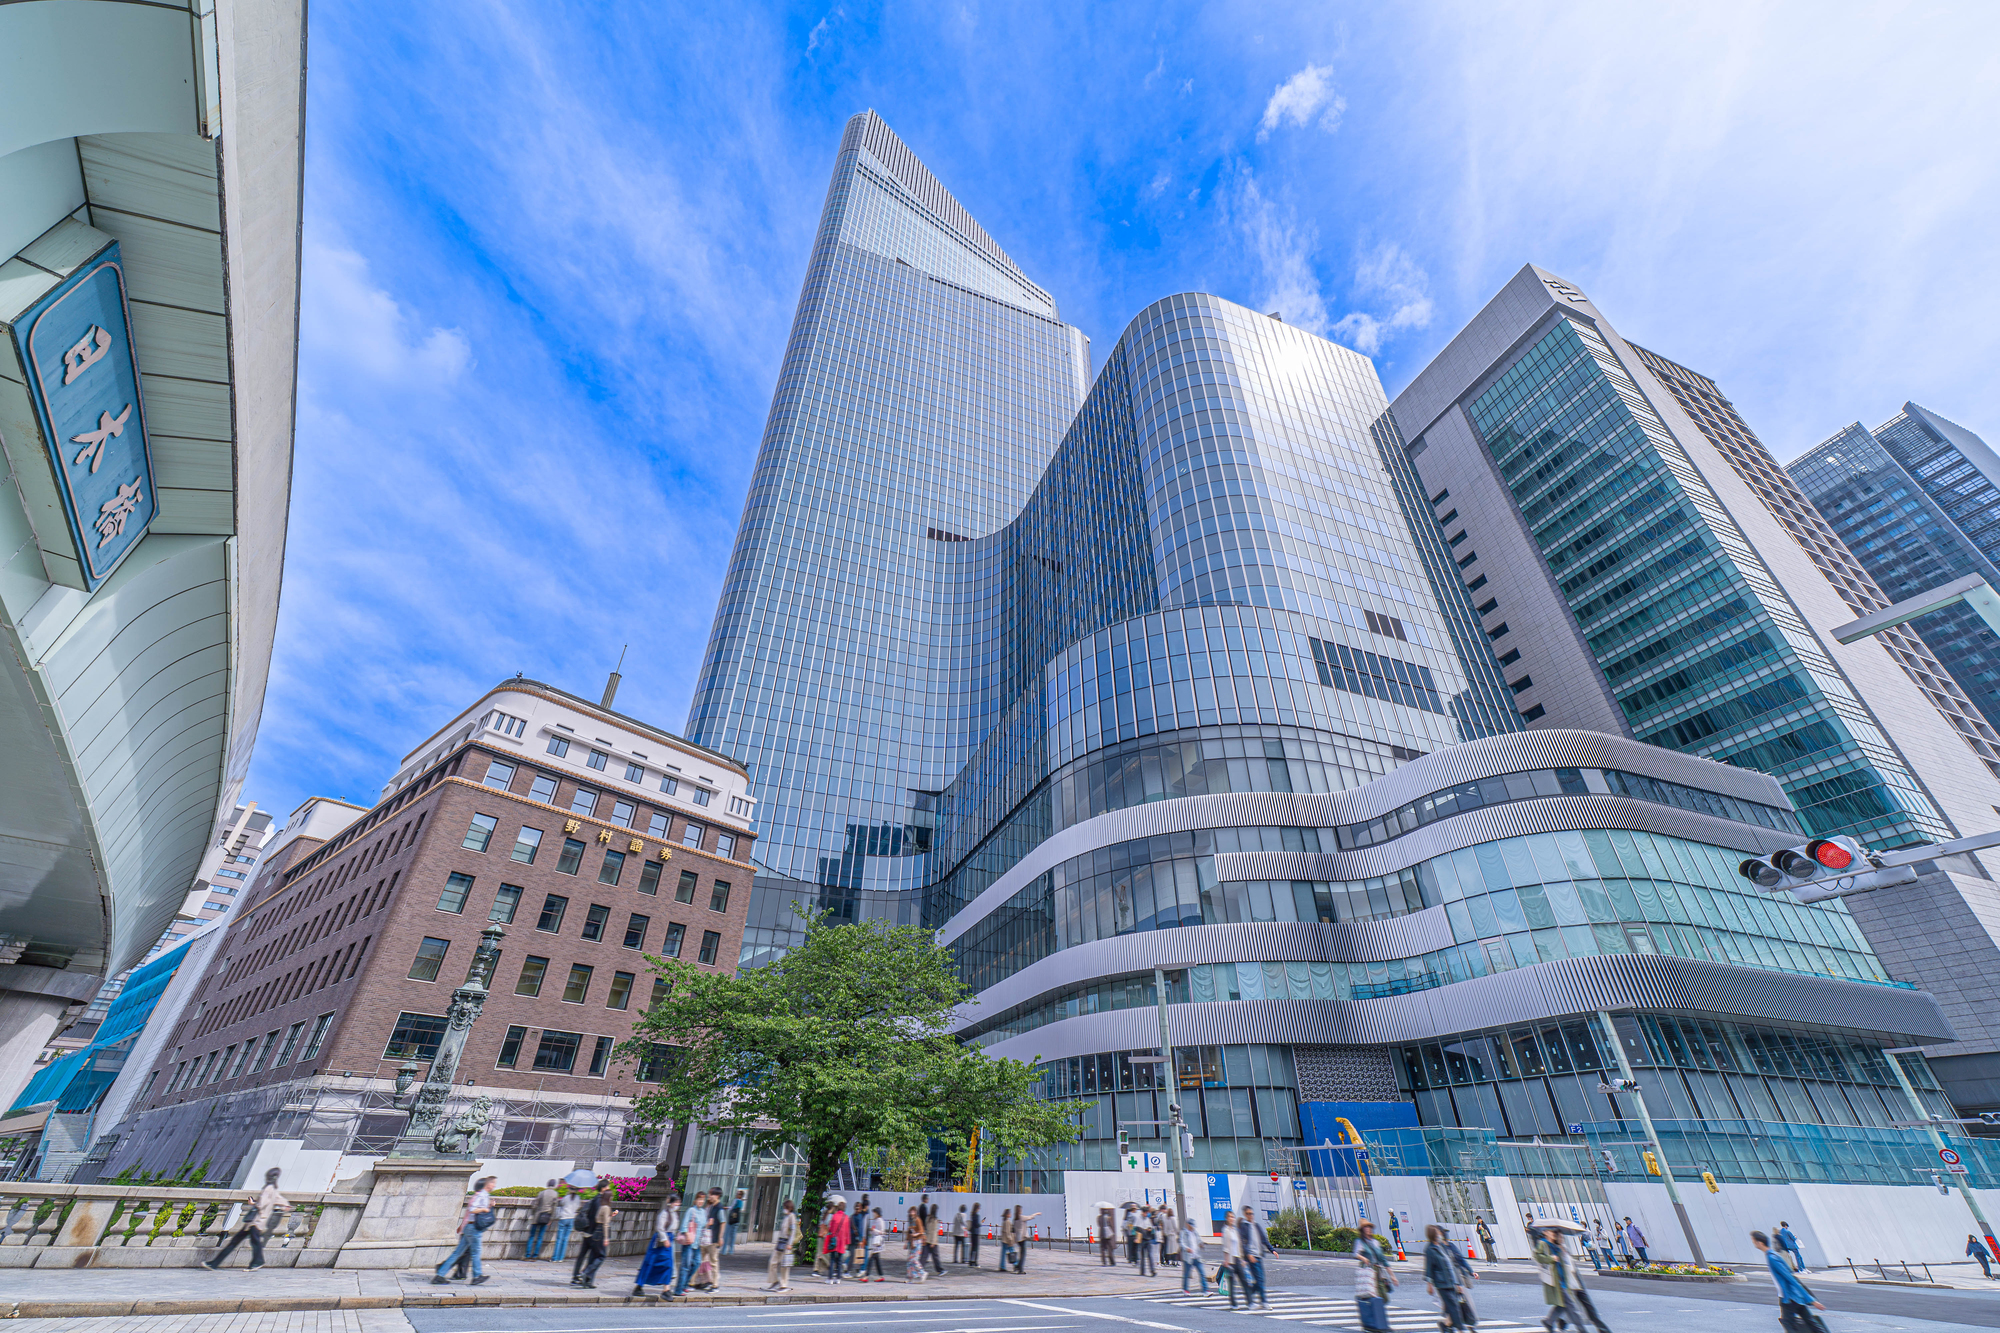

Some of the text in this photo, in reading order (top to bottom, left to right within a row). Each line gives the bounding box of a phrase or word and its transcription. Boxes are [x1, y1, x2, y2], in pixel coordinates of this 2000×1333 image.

[62, 324, 143, 550] 日本橋
[564, 818, 673, 861] 野村證券
